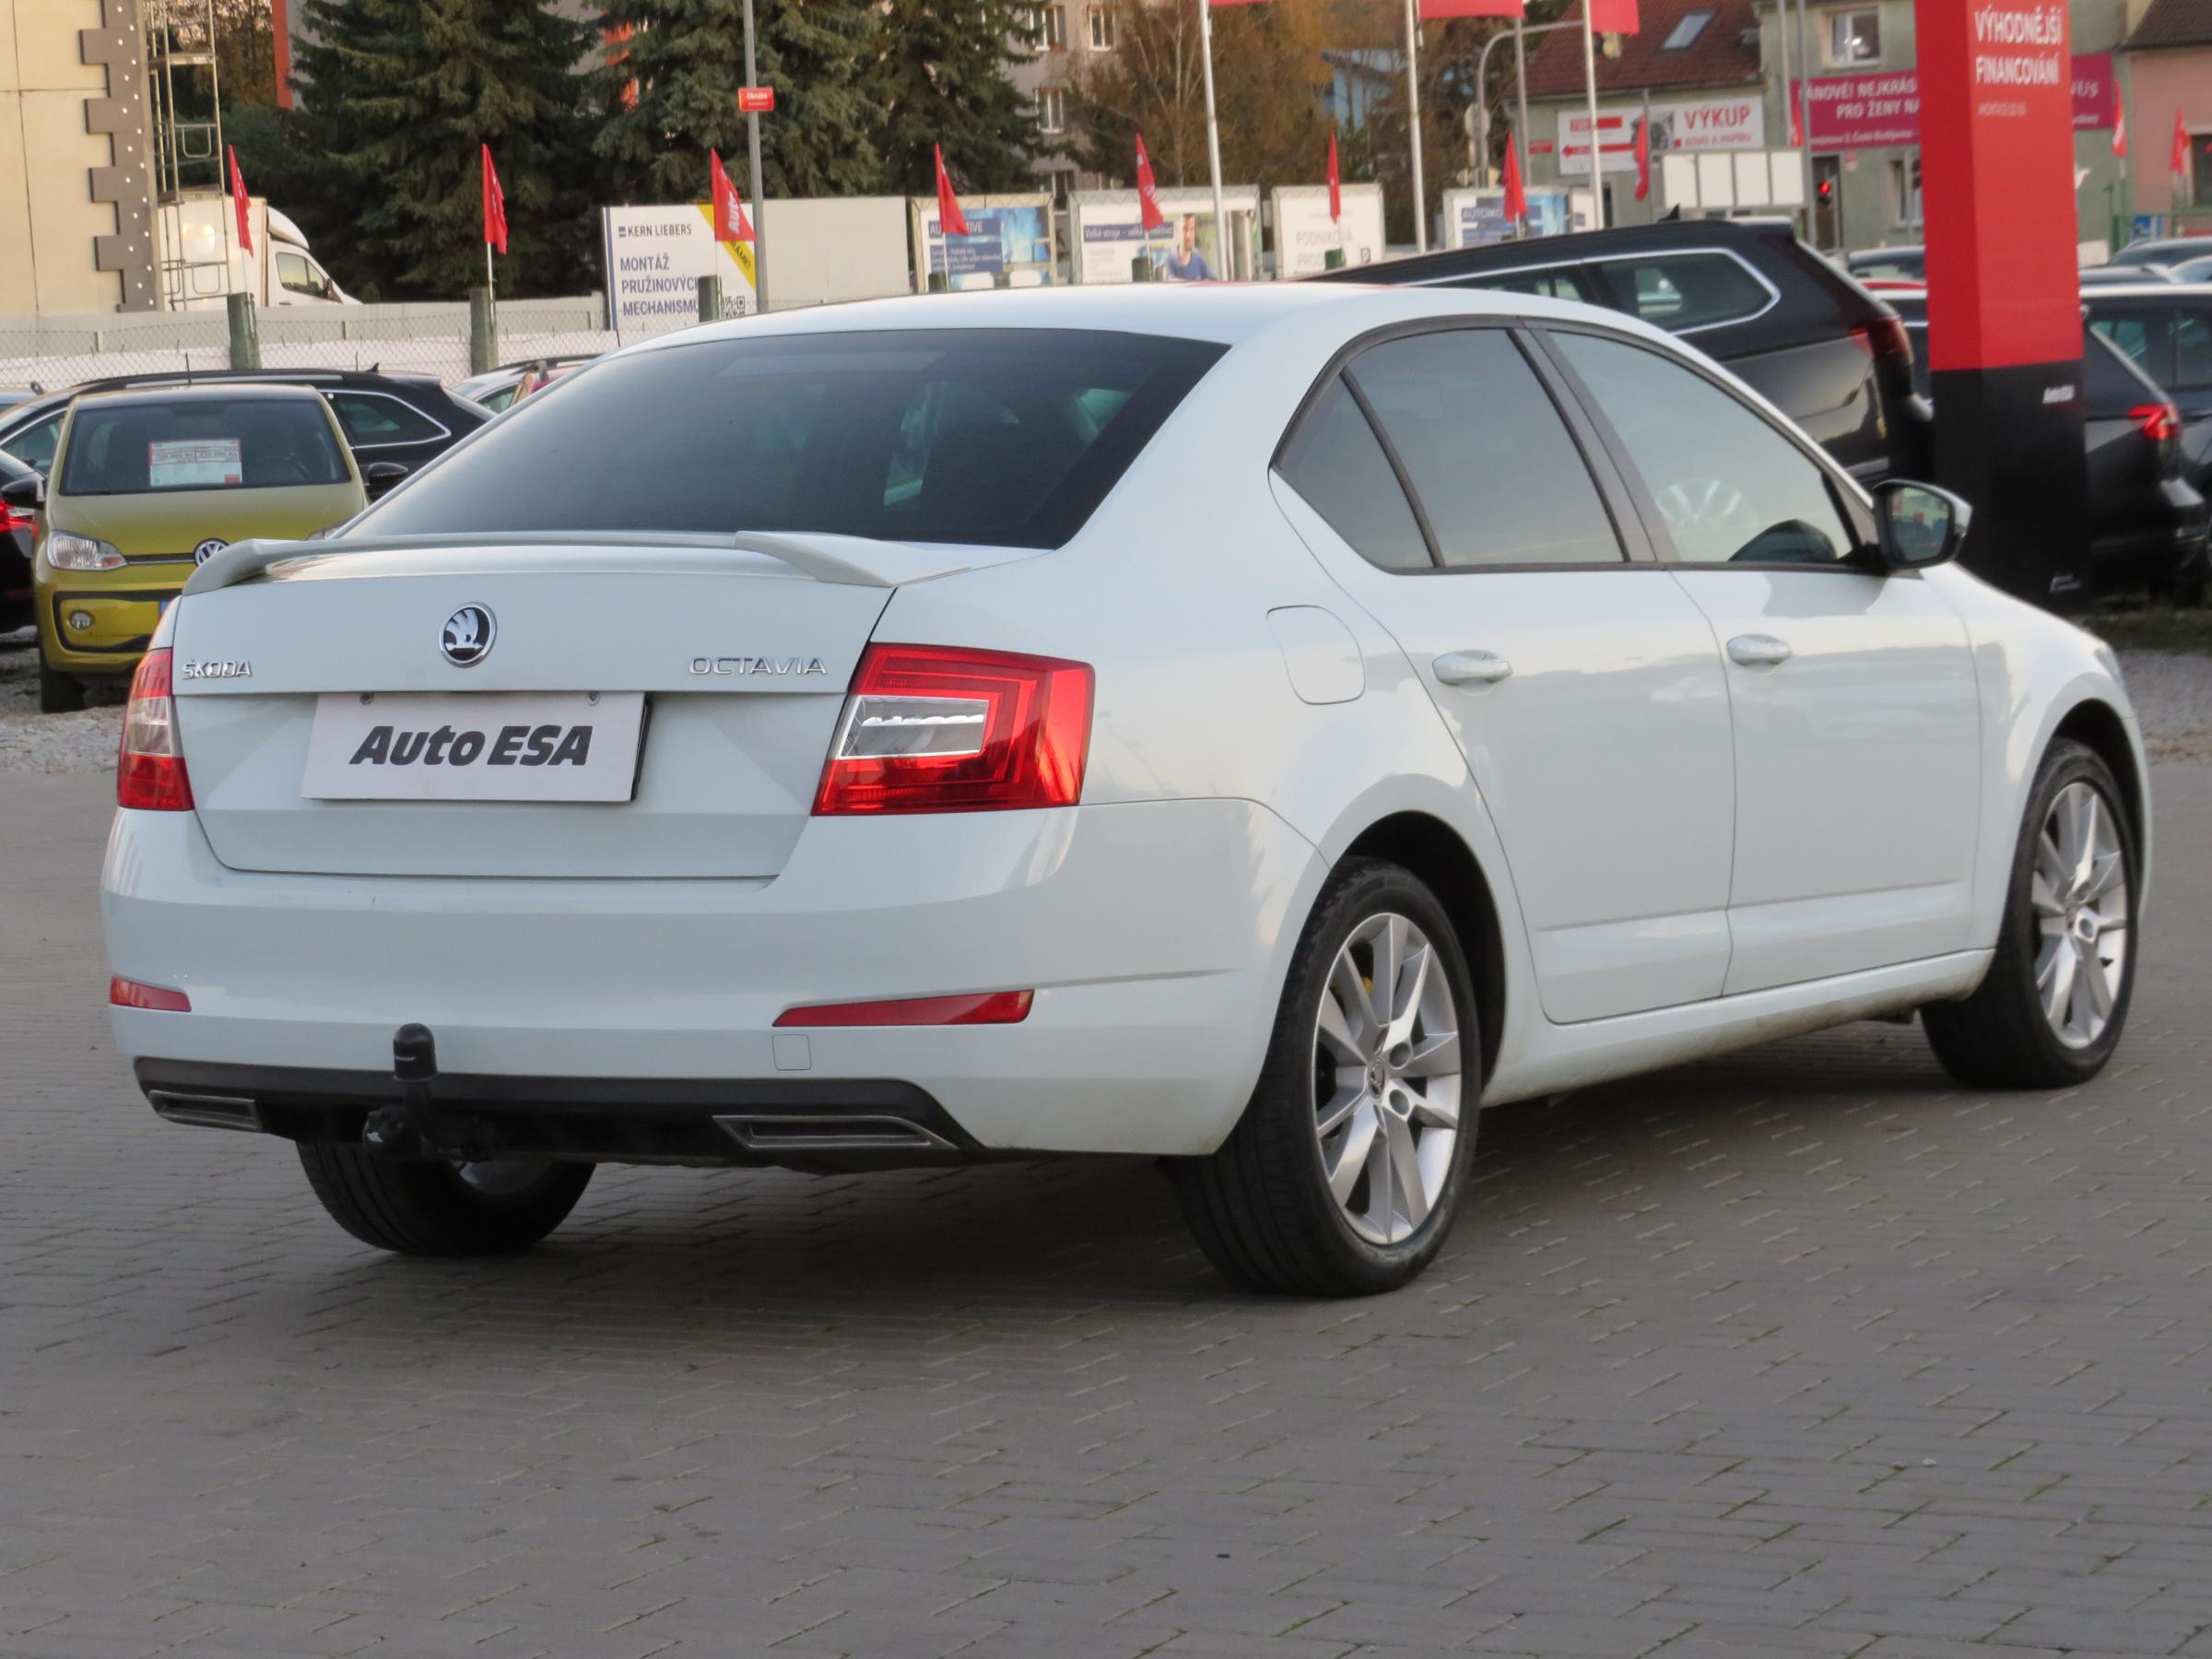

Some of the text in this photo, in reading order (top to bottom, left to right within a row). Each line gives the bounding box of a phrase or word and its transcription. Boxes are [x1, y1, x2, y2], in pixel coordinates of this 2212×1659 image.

[1974, 4, 2063, 44] VÝHODNĚJŠÍ
[1975, 52, 2060, 85] FINANCOVÁNÍ
[1684, 103, 1750, 130] VÝKUP
[1837, 103, 1864, 120] PRO
[1868, 99, 1900, 118] ŽENY
[628, 224, 692, 237] KERN LIEBERS
[620, 253, 670, 271] MONTÁŽ
[182, 660, 252, 680] ŠKODA
[689, 657, 827, 675] OCTAVIA
[348, 724, 593, 766] Auto ESA
